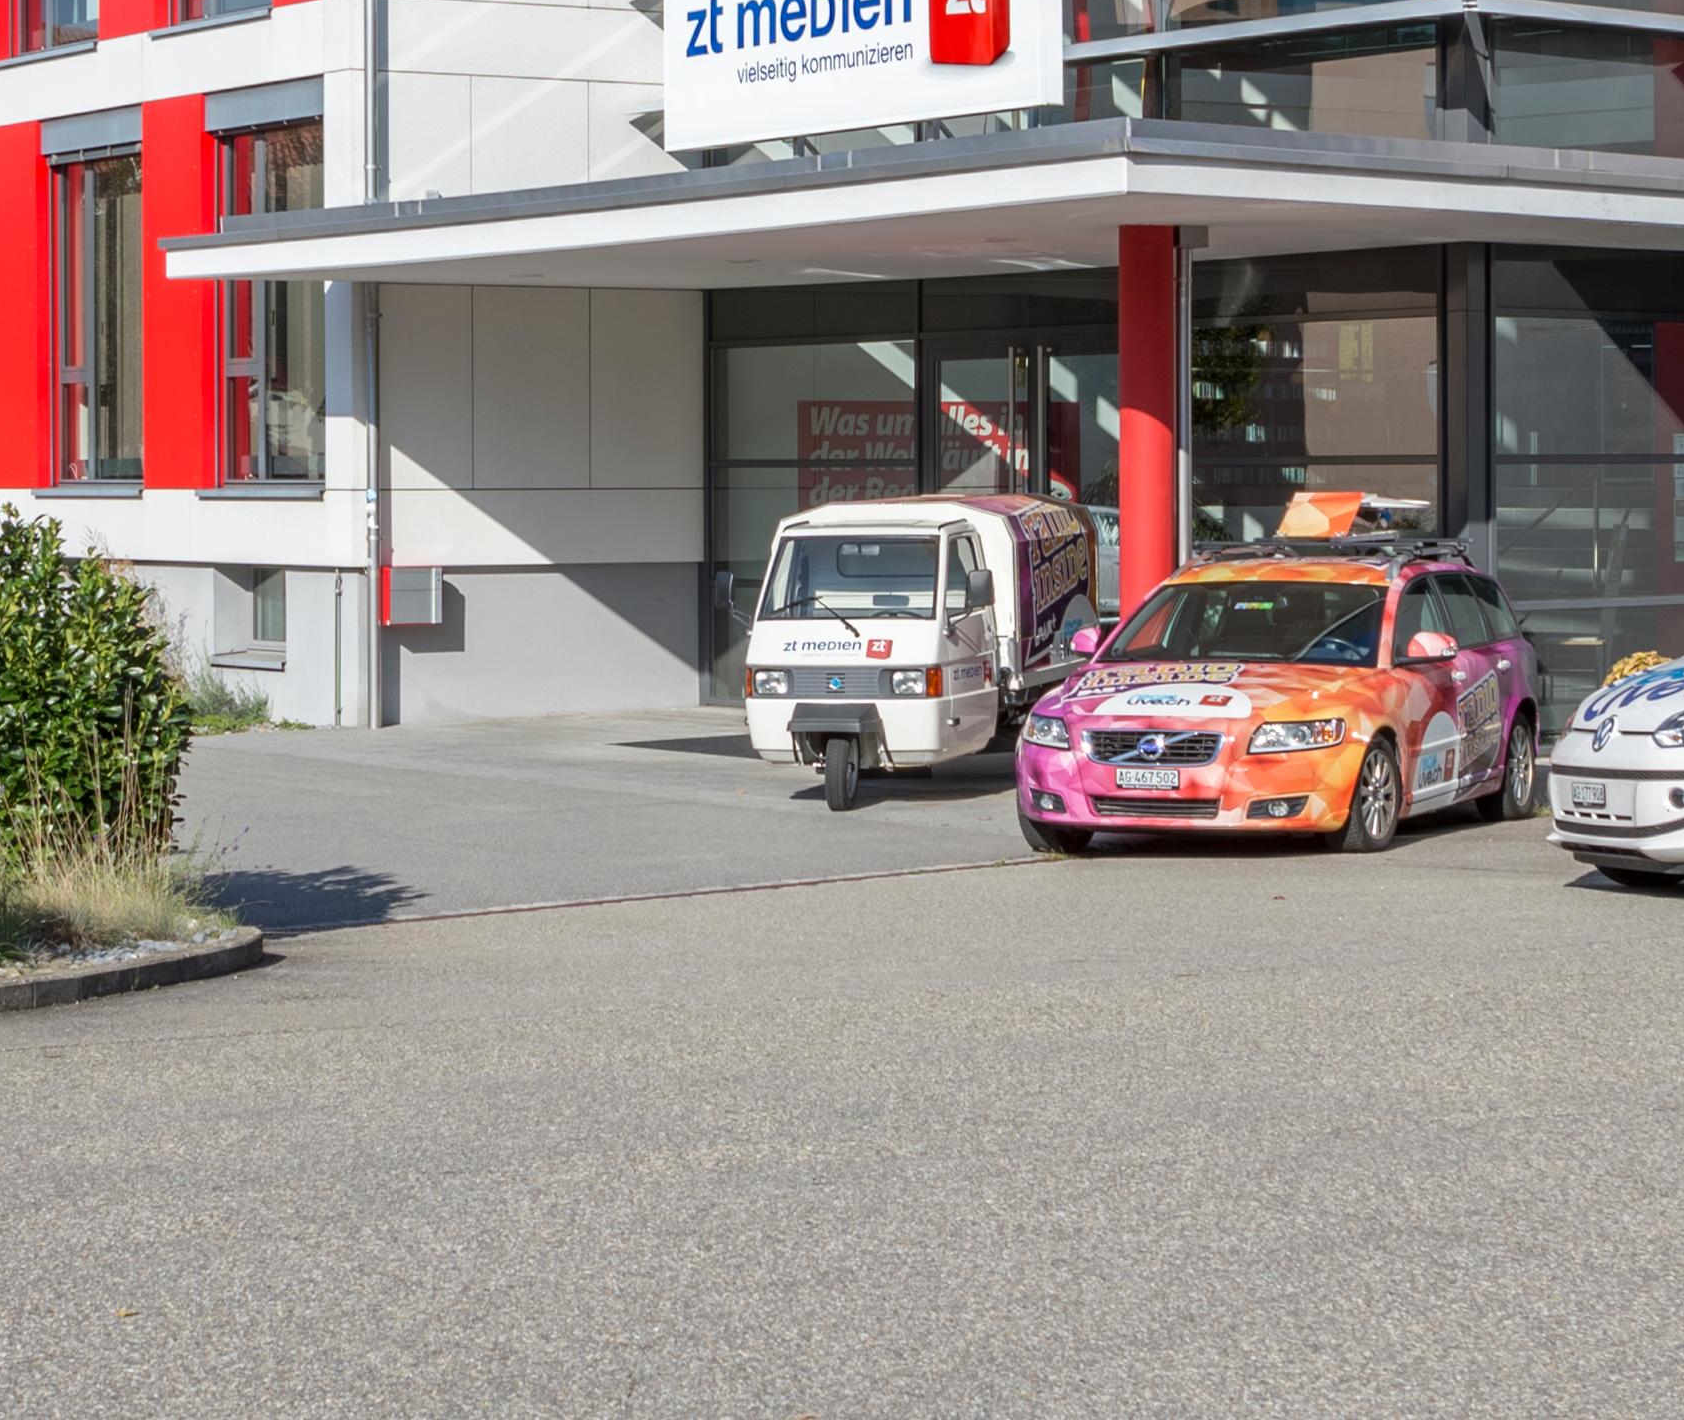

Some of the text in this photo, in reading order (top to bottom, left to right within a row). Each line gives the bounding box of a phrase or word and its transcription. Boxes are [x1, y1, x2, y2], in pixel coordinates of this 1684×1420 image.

[737, 41, 913, 84] vielseitig kommunizieren
[811, 406, 869, 437] Was
[941, 405, 993, 436] lles
[783, 640, 797, 652] zt
[871, 640, 886, 652] zt
